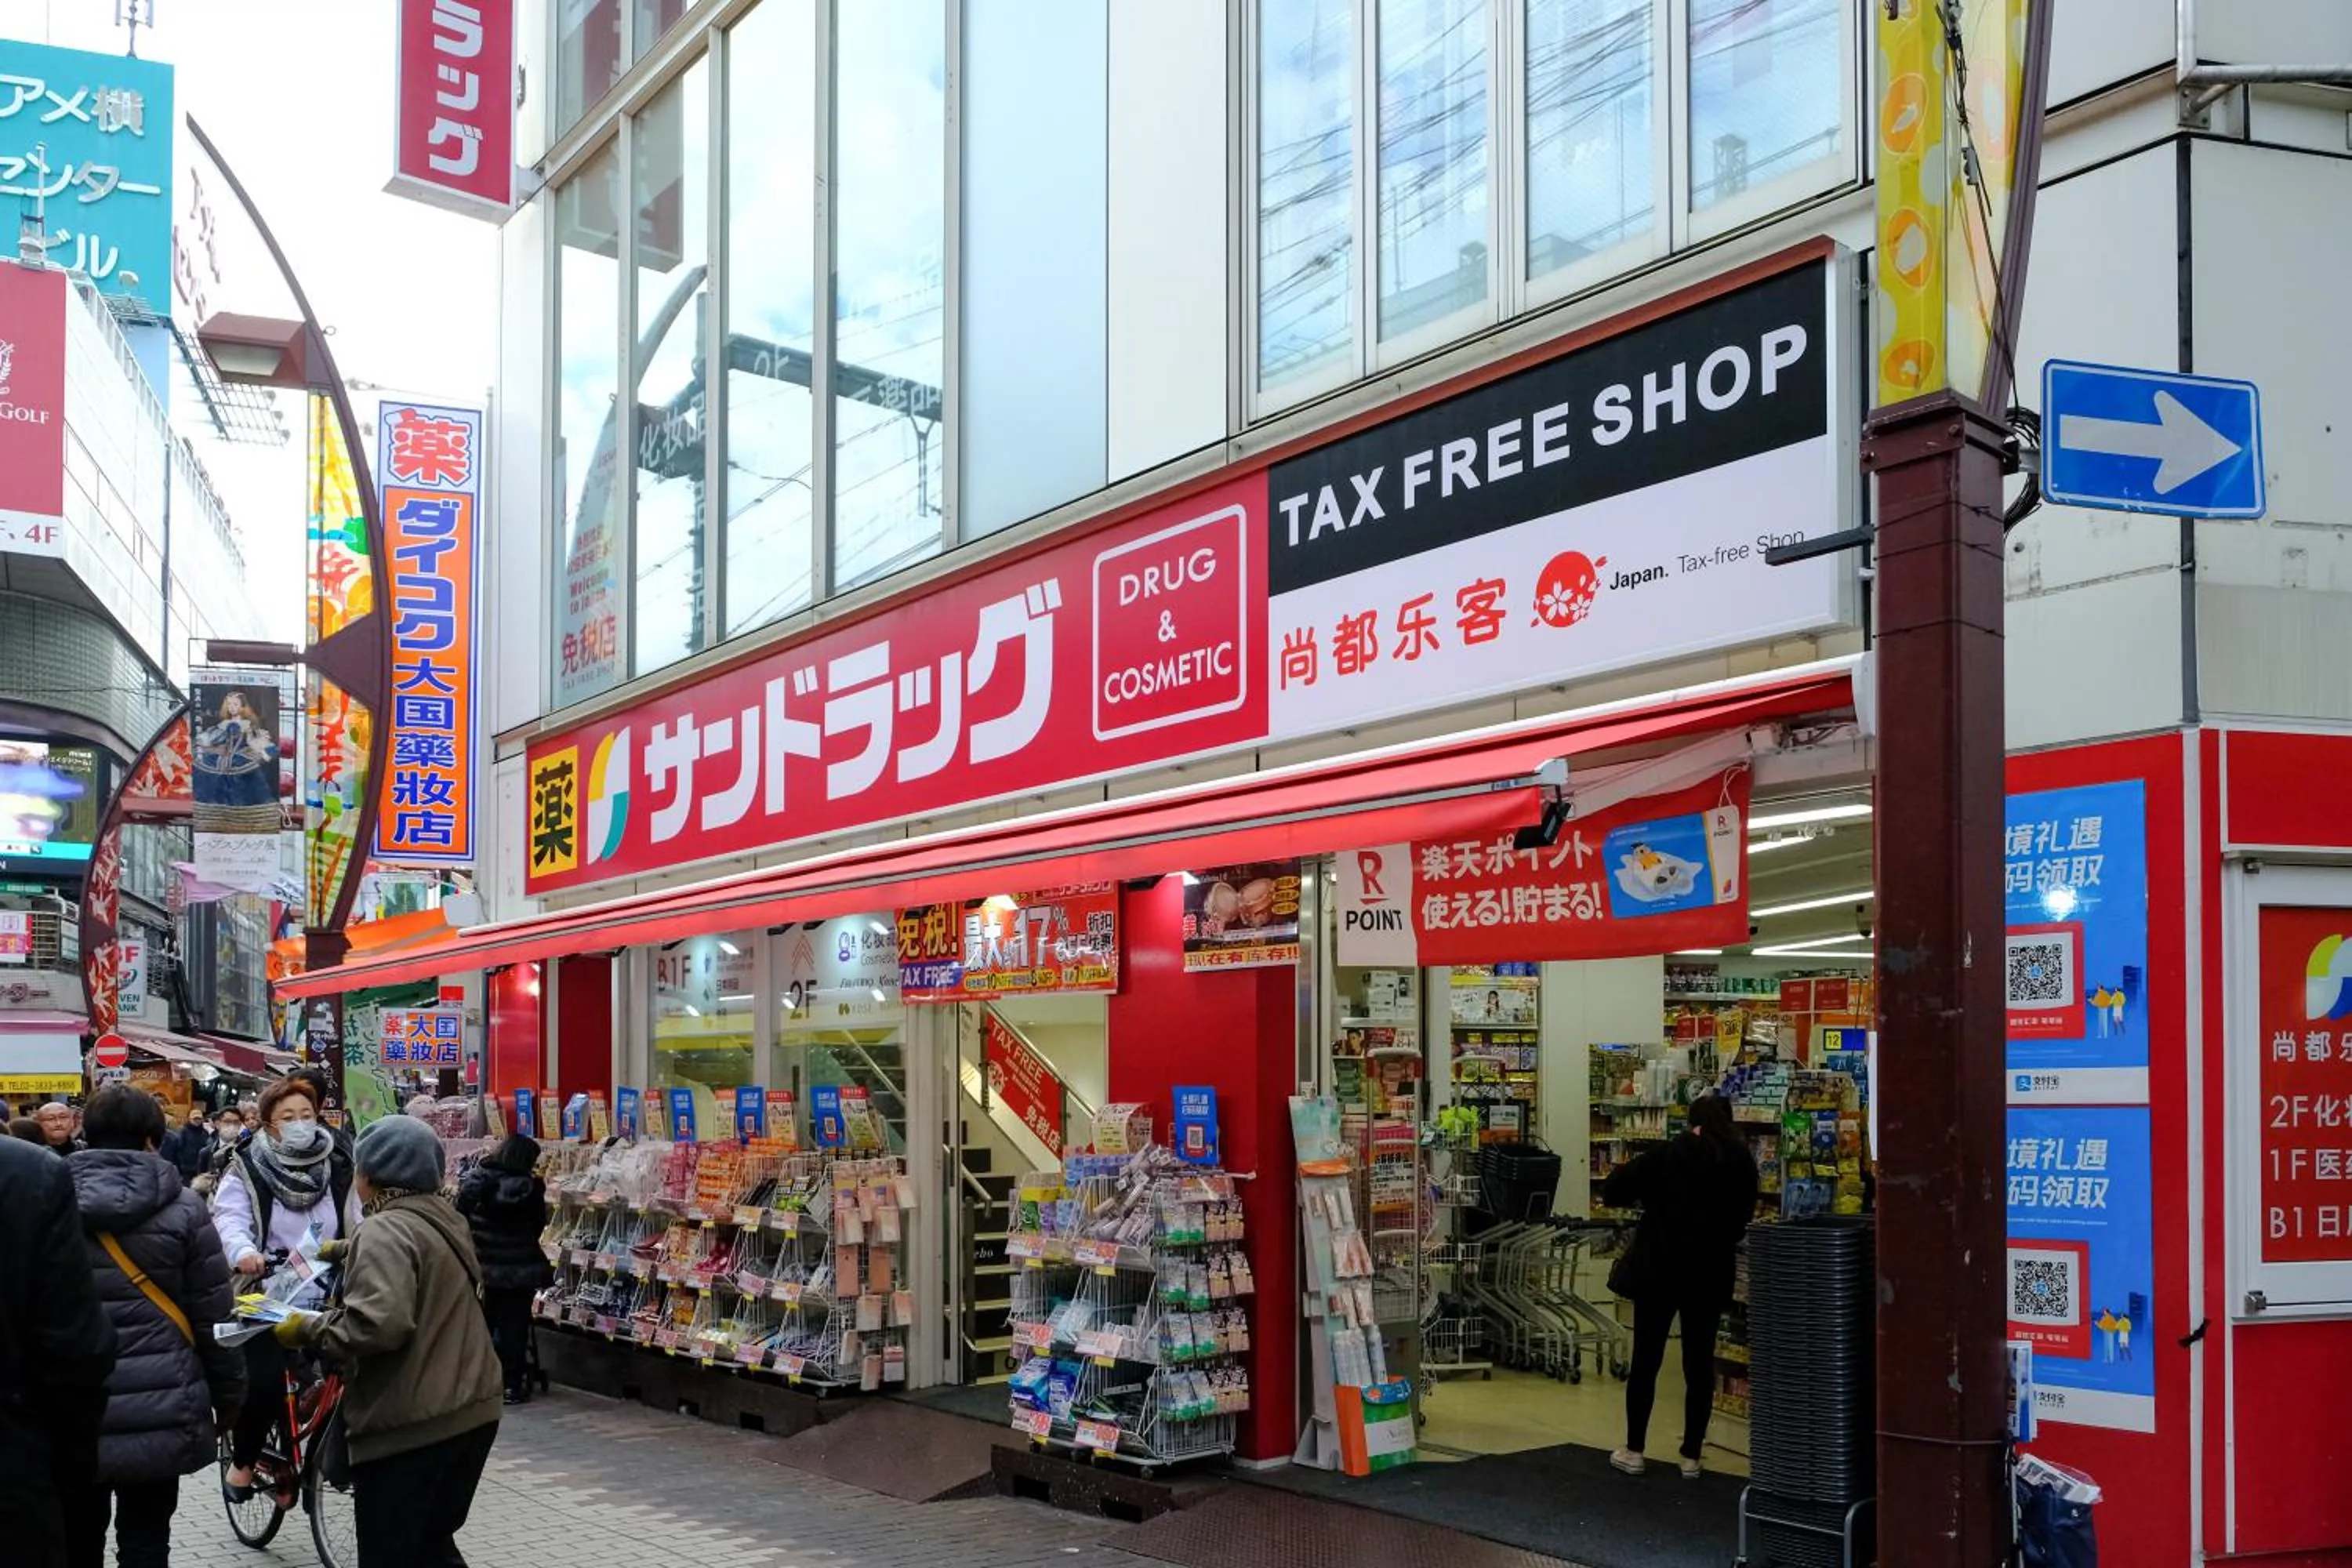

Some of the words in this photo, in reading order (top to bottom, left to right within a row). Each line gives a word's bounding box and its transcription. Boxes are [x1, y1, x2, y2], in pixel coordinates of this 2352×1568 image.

[0, 74, 144, 137] アメ横
[389, 408, 471, 486] 薬
[1279, 465, 1386, 547] TAX
[1403, 402, 1570, 510] FREE
[1592, 324, 1807, 446] SHOP
[1120, 548, 1217, 606] DRUG
[1610, 563, 1669, 590] Japan.
[1676, 544, 1750, 575] Tax-free
[1157, 609, 1177, 642] &
[1279, 577, 1507, 691] 尚都乐客
[1104, 641, 1232, 704] COSMETIC
[644, 577, 1063, 845] サンドラッグ
[534, 760, 574, 869] 薬
[1346, 909, 1403, 931] POINT
[1421, 881, 1603, 931] 使える!貯まる!
[117, 993, 140, 1003] VEN
[789, 979, 818, 1020] 2F
[898, 967, 920, 987] TAX
[991, 1021, 1014, 1054] TAX
[1013, 1047, 1046, 1084] FREE
[2007, 1138, 2108, 1171] 境礼遇
[2007, 1175, 2110, 1210] 码领取
